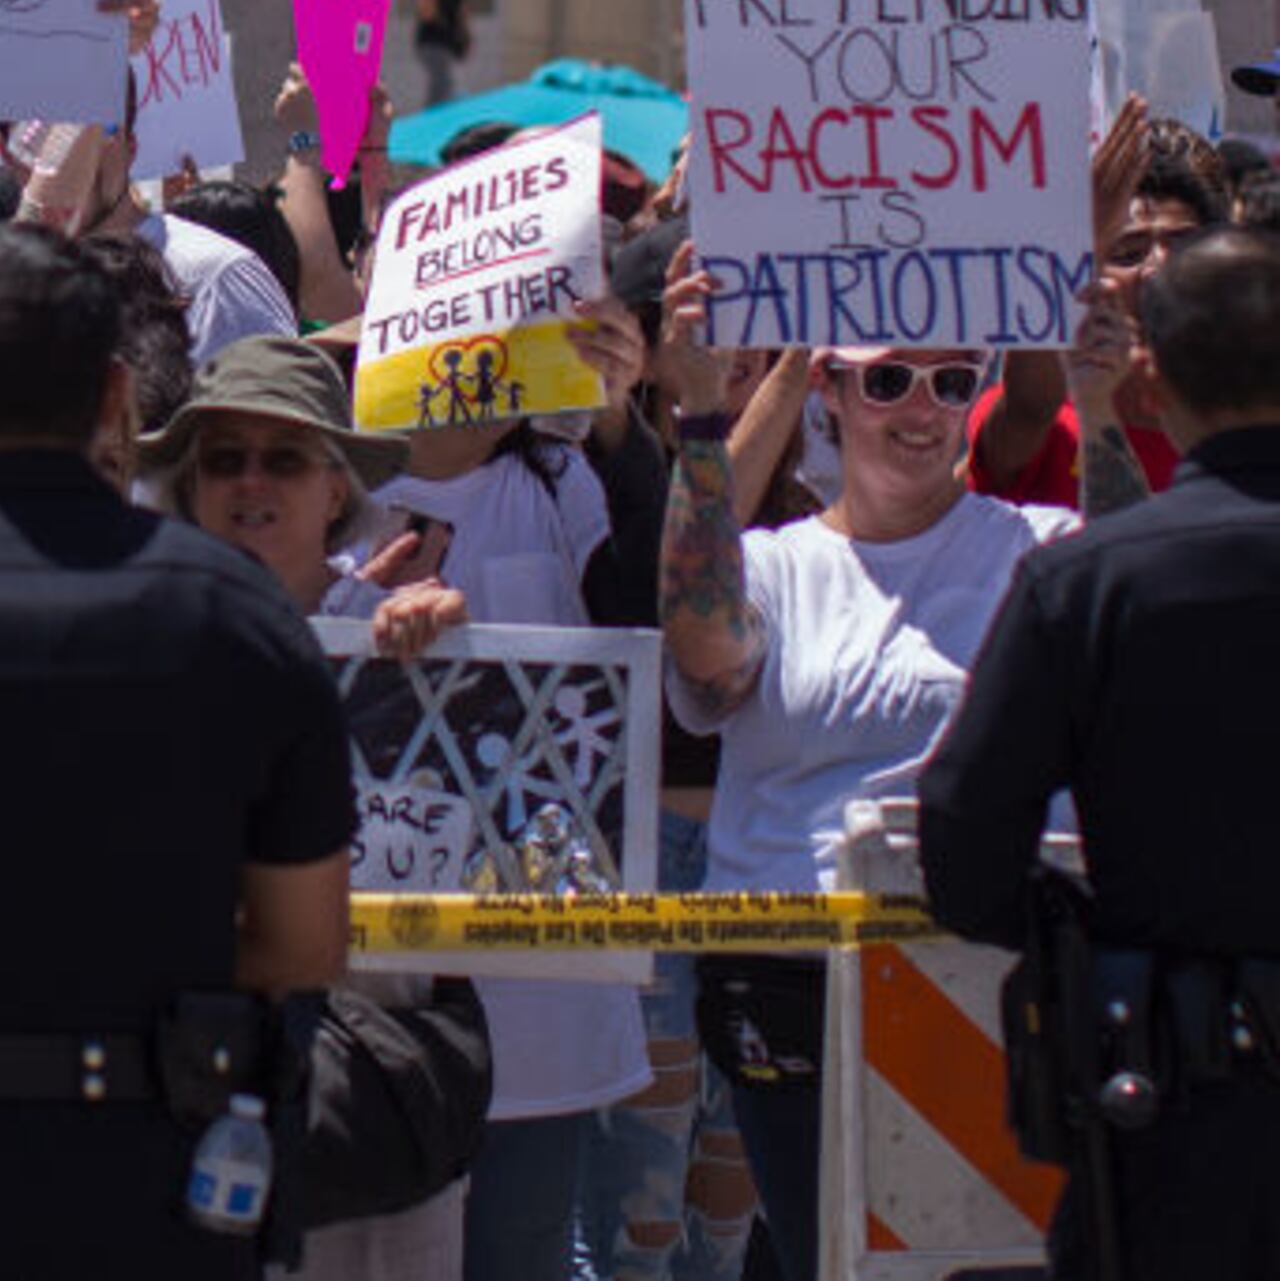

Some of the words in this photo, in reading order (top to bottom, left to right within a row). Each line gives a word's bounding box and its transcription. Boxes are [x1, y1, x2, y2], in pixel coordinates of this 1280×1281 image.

[776, 24, 998, 104] YOUR
[703, 101, 1048, 193] RACISM
[393, 156, 570, 252] FAMILIES
[819, 191, 925, 250] IS
[415, 214, 543, 286] BELONG
[367, 266, 584, 354] TOGETHER
[701, 247, 1094, 348] PATRIOTISM
